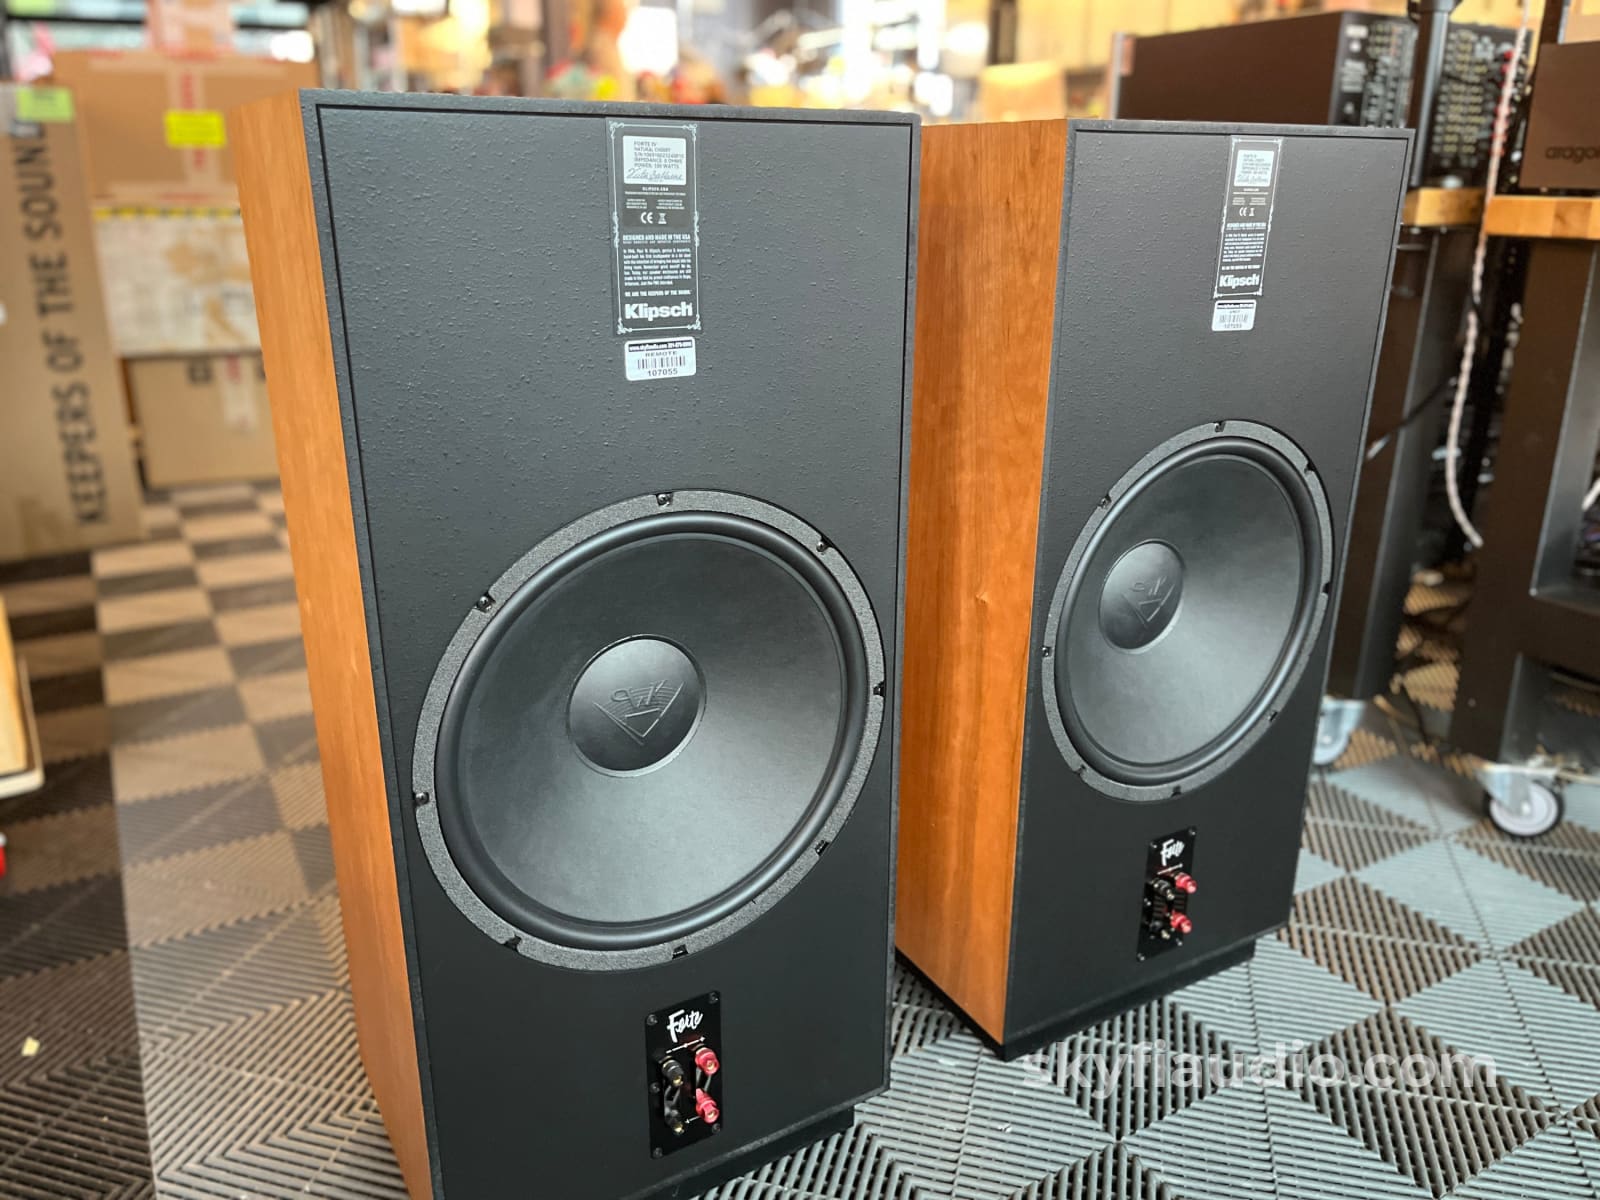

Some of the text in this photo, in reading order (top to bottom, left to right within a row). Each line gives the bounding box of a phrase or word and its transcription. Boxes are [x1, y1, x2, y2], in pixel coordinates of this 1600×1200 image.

[28, 252, 74, 318] THE
[1219, 273, 1260, 289] Klipsch
[625, 301, 693, 321] Klipsch
[41, 328, 83, 373] OF
[647, 368, 678, 376] 107055
[52, 380, 109, 527] KEEPERS
